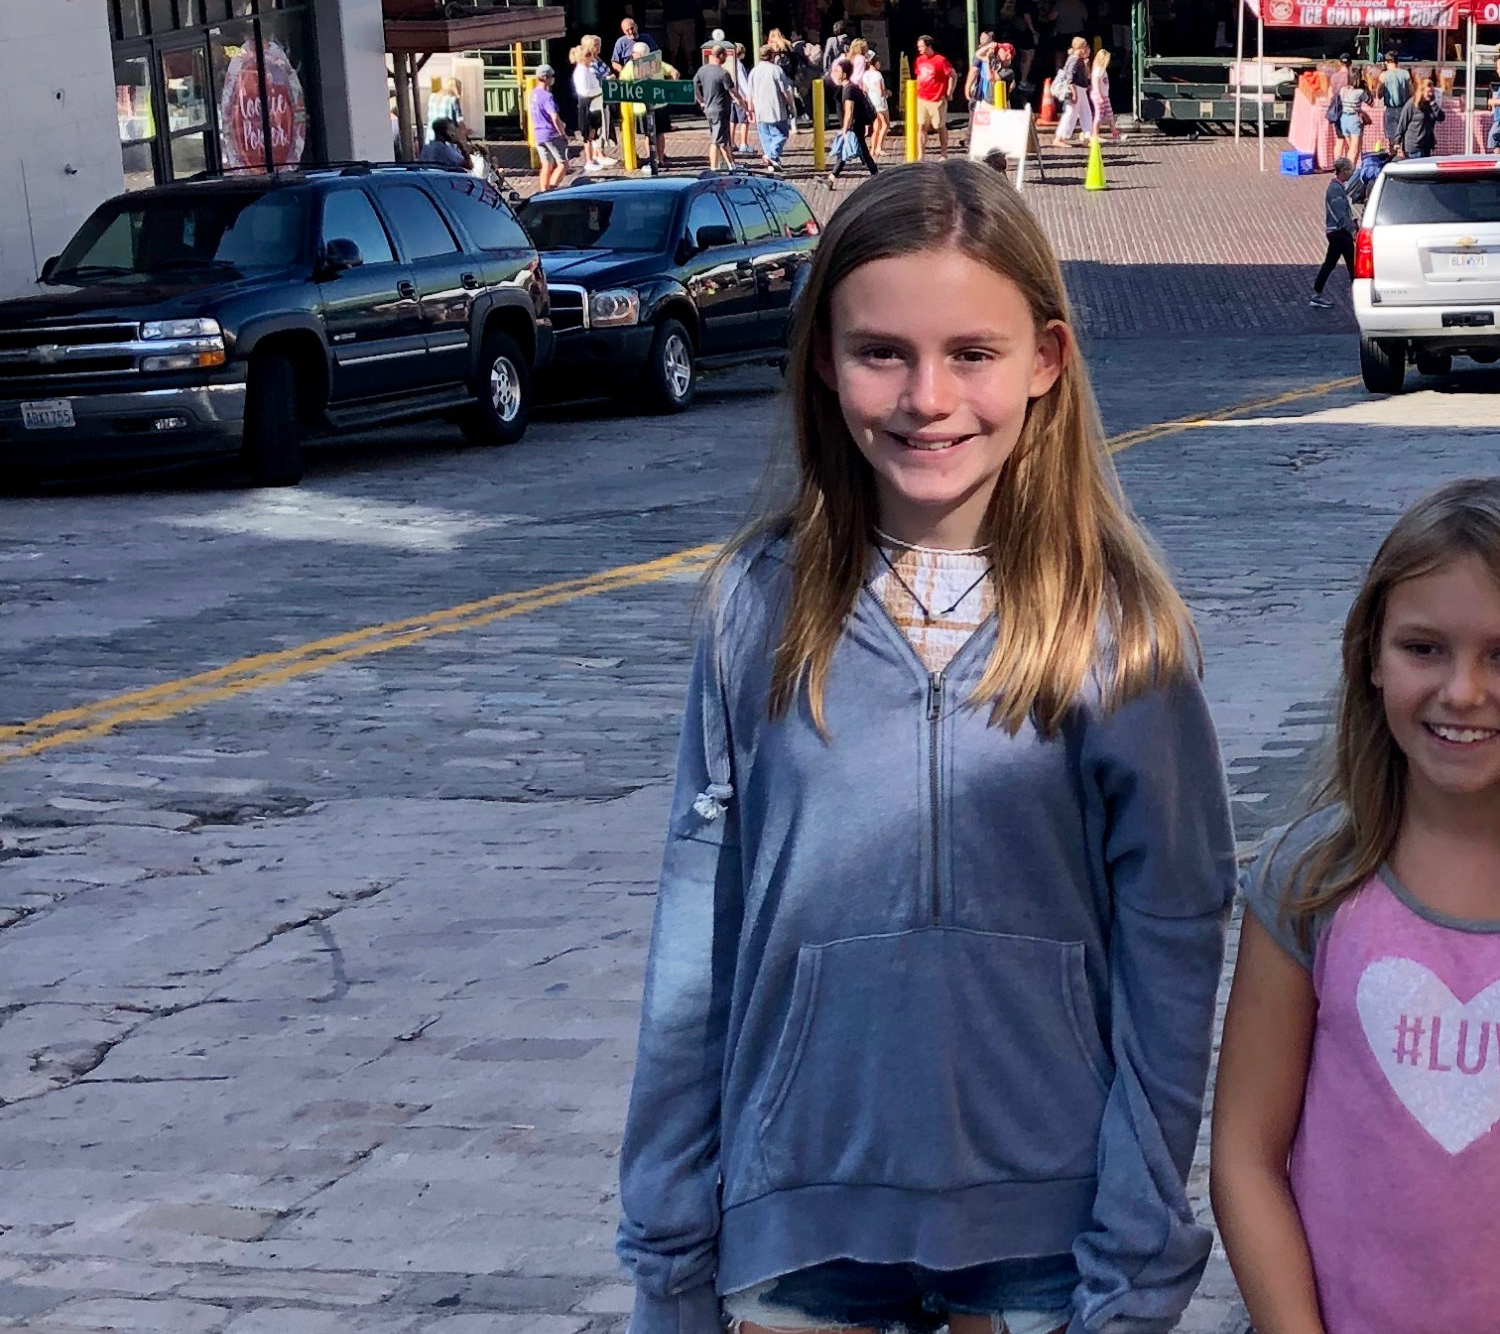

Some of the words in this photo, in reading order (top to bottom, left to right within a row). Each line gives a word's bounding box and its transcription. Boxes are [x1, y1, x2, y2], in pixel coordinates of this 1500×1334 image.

[1301, 6, 1323, 25] ICE
[1327, 7, 1362, 27] COLD
[1365, 7, 1406, 28] APPLE
[607, 81, 644, 99] Pike
[653, 87, 666, 100] Pl
